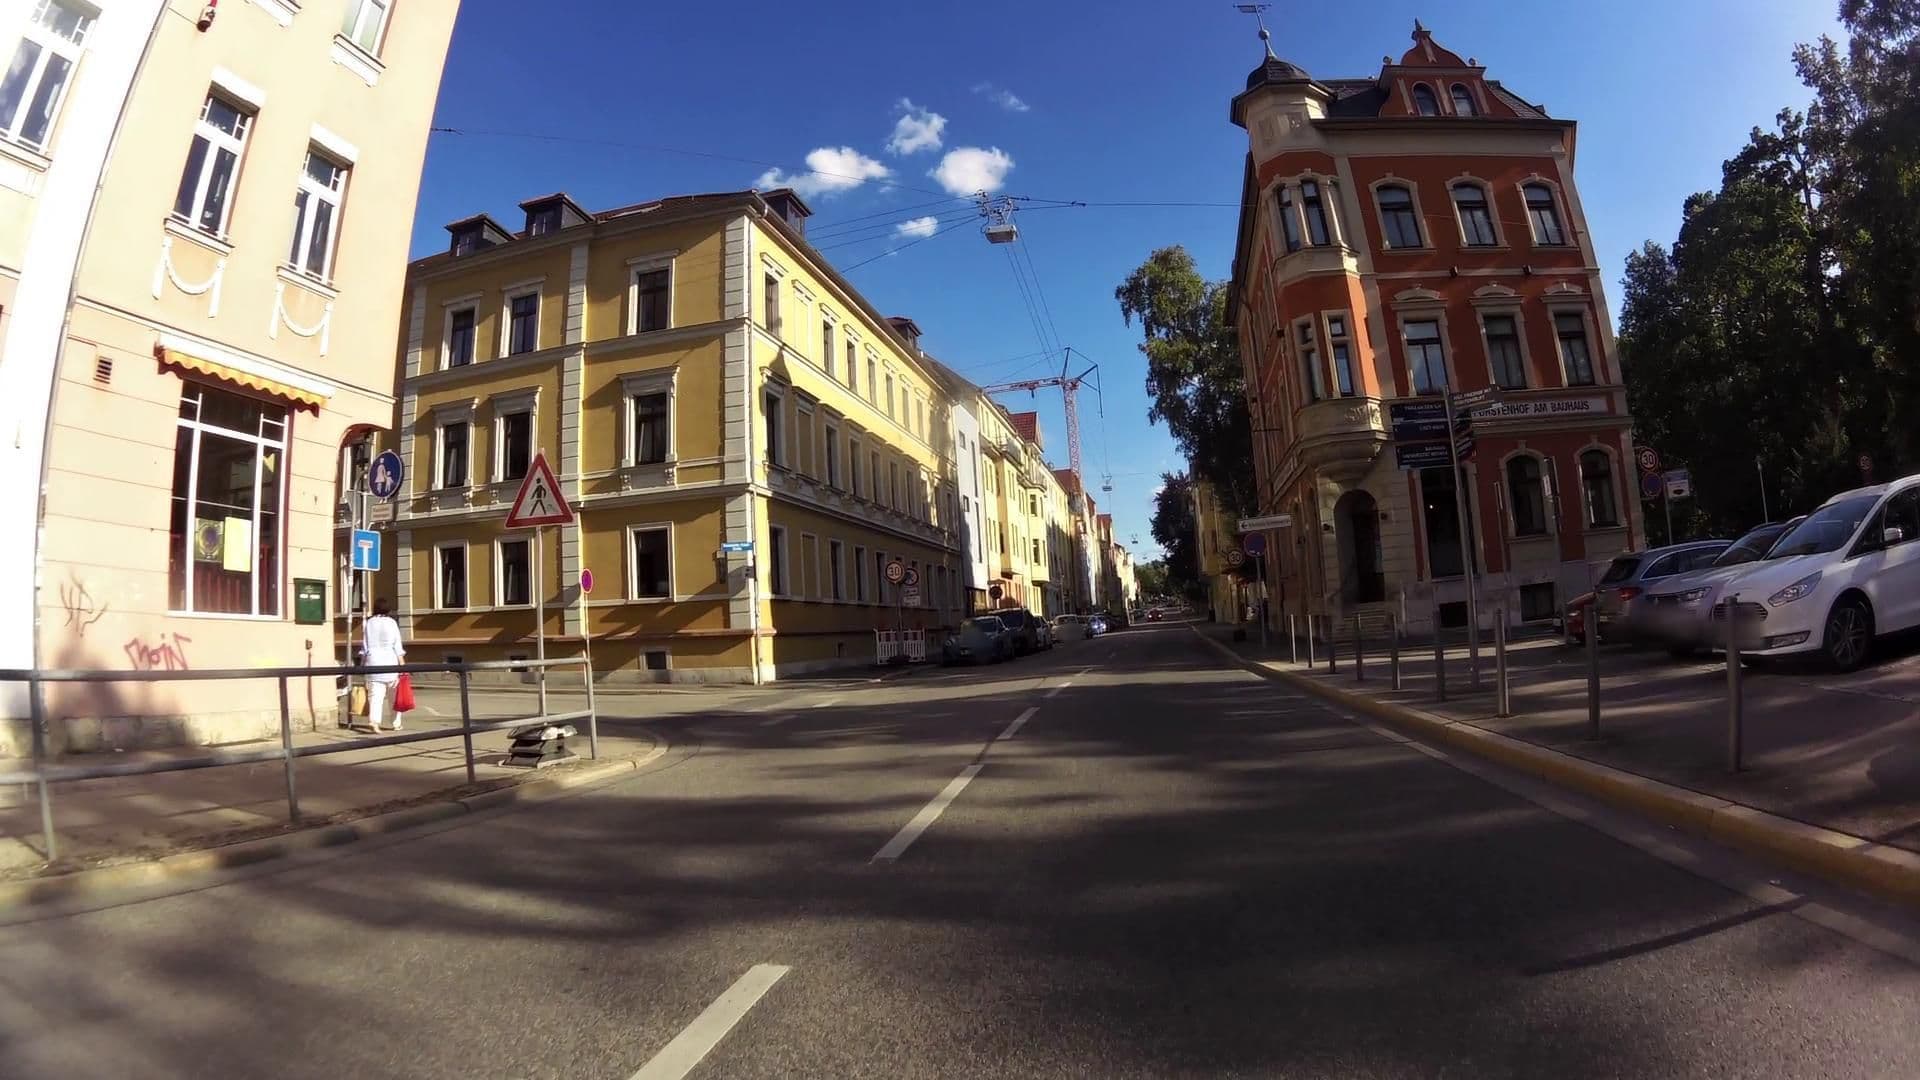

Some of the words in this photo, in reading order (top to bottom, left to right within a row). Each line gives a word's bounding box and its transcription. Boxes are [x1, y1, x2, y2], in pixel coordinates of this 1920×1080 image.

[1534, 402, 1547, 413] AM
[1551, 400, 1590, 412] BAUHAUS
[1643, 454, 1654, 465] 30
[889, 566, 900, 576] 30
